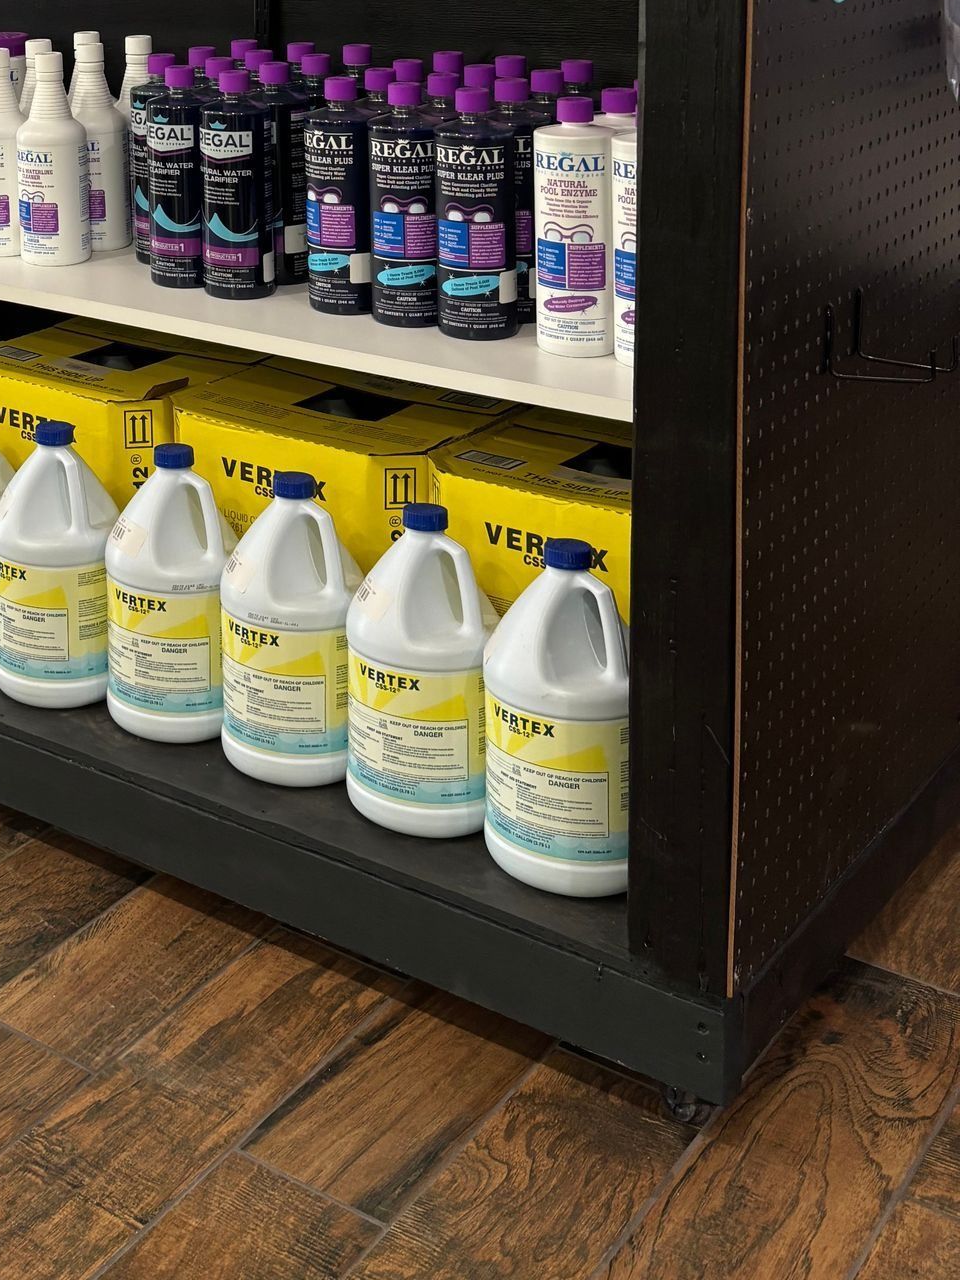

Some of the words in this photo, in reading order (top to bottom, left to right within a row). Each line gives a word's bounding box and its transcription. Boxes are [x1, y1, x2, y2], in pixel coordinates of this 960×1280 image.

[148, 126, 192, 142] EGAL
[304, 132, 354, 150] EGAL
[436, 146, 504, 166] REGAL
[536, 152, 605, 173] REGAL
[392, 165, 418, 174] KLEAR
[421, 164, 435, 173] PLU
[457, 172, 484, 181] KLEAR
[486, 172, 504, 180] PLUS
[204, 175, 238, 184] CLARIFIER
[547, 178, 588, 189] NATURAL
[540, 186, 559, 196] POOL
[560, 188, 598, 198] ENZYME
[222, 456, 327, 502] VERX
[524, 472, 560, 486] THIS
[562, 484, 601, 494] SIDE
[604, 488, 630, 497] UP
[223, 506, 248, 523] LIQUID
[485, 522, 608, 572] VERX
[116, 588, 167, 612] VERTEX
[22, 614, 46, 622] DANGER
[228, 620, 280, 648] VERTEX
[360, 662, 420, 692] VERTEX
[274, 684, 301, 692] DANGER
[494, 702, 555, 738] VERTEX
[548, 780, 580, 790] DANGER
